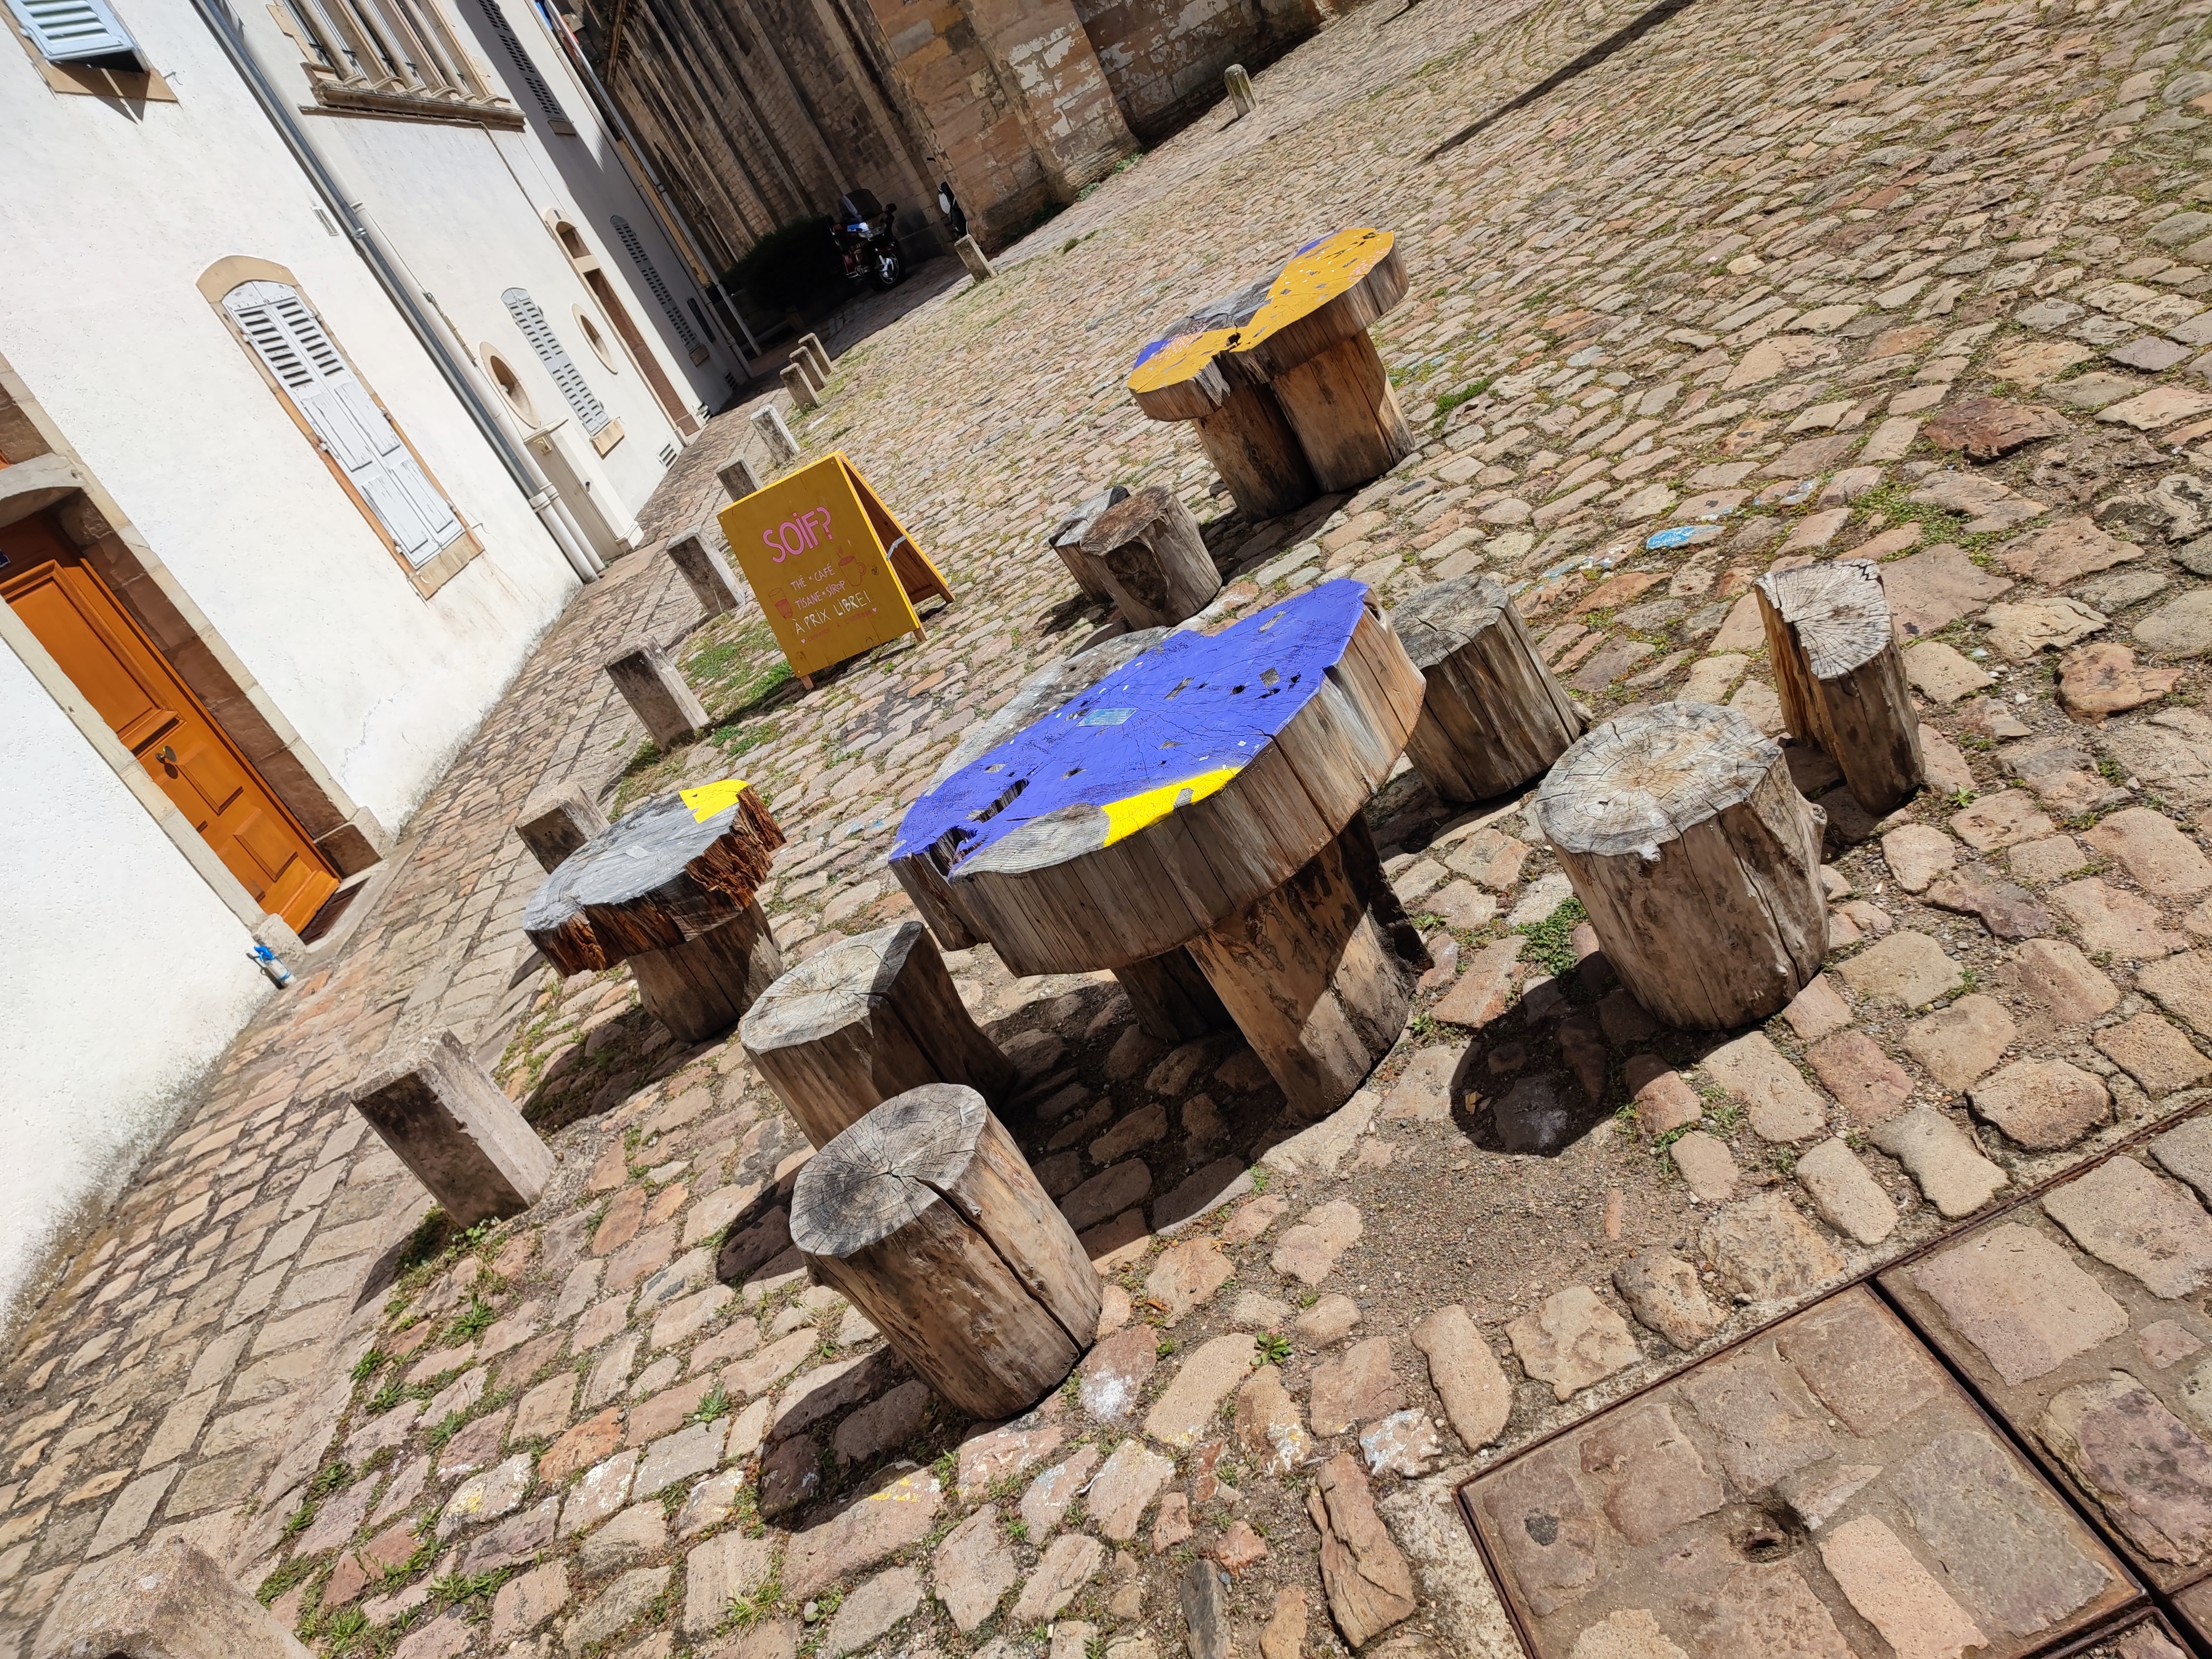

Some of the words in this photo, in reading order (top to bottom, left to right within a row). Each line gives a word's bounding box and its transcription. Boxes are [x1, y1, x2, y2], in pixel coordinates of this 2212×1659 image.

[790, 575, 807, 591] THÉ
[814, 562, 835, 582] CAFÉ
[792, 618, 806, 635] À
